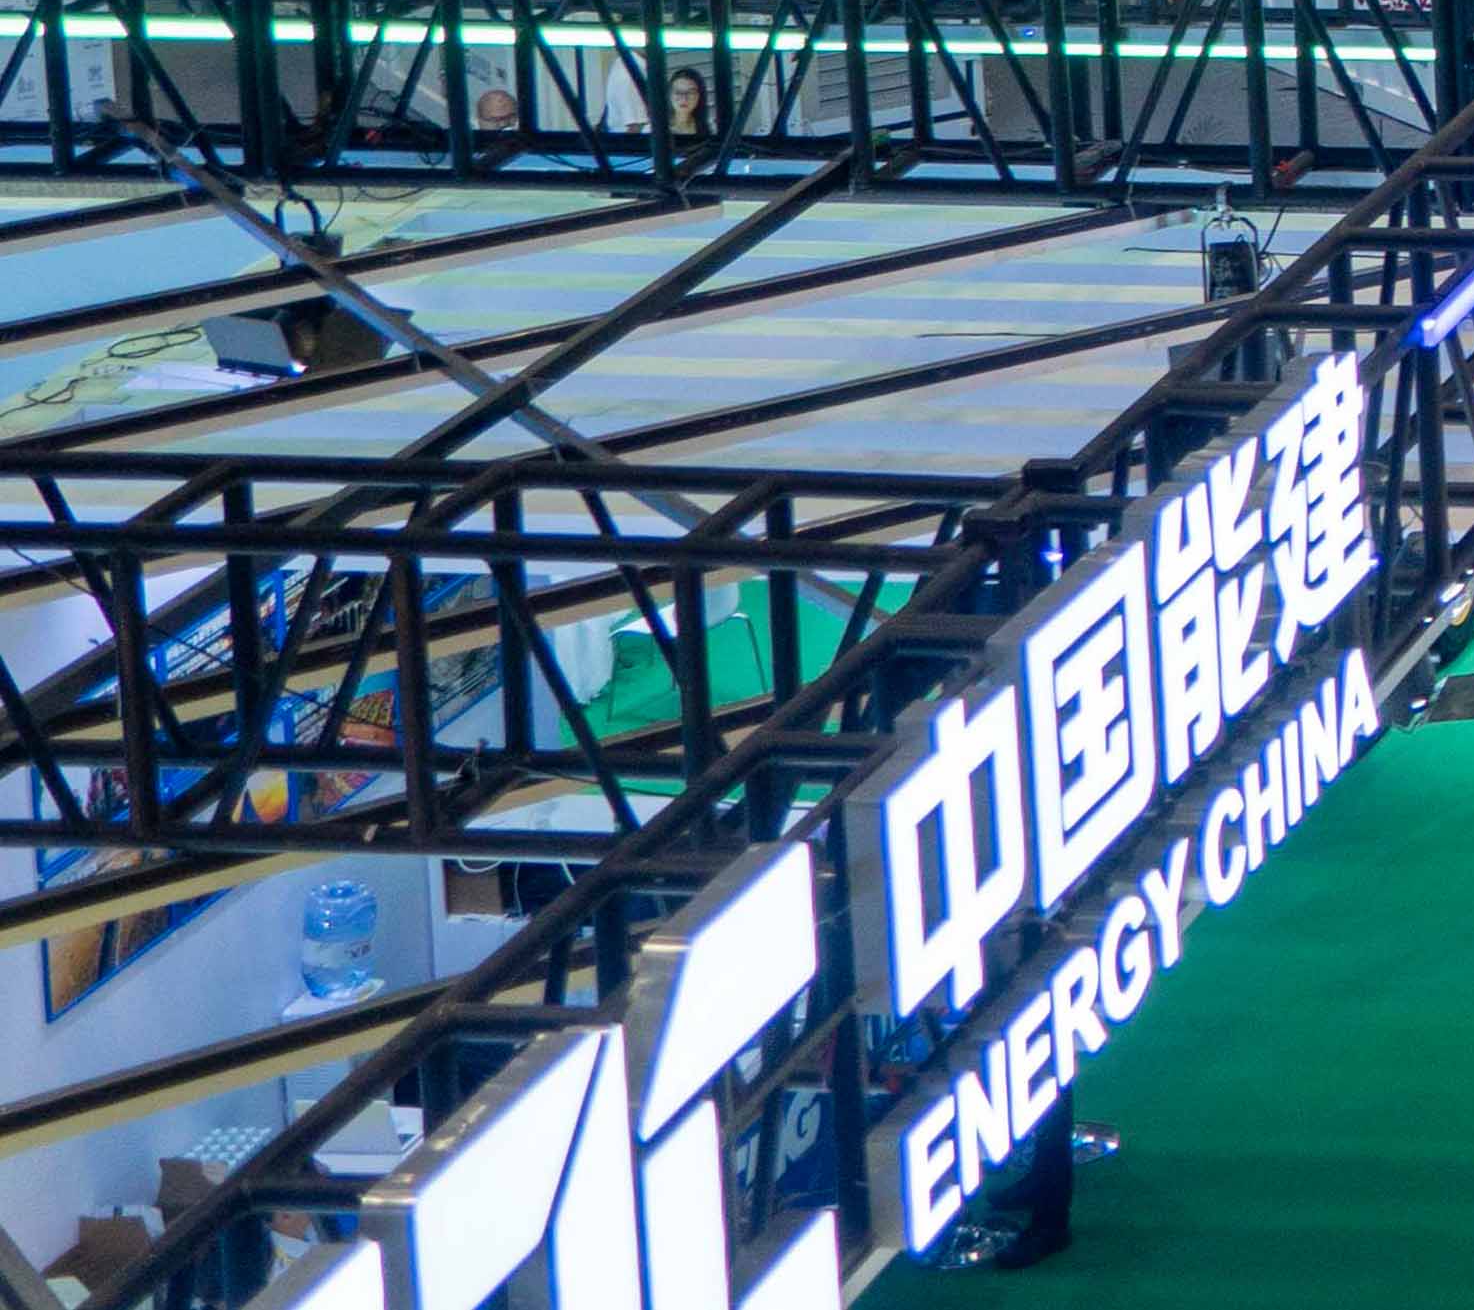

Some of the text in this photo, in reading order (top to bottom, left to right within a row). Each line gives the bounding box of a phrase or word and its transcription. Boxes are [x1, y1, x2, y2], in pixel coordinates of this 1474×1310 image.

[884, 353, 1378, 1018] 中国能建
[901, 650, 1383, 1258] ENERGY CHINA
